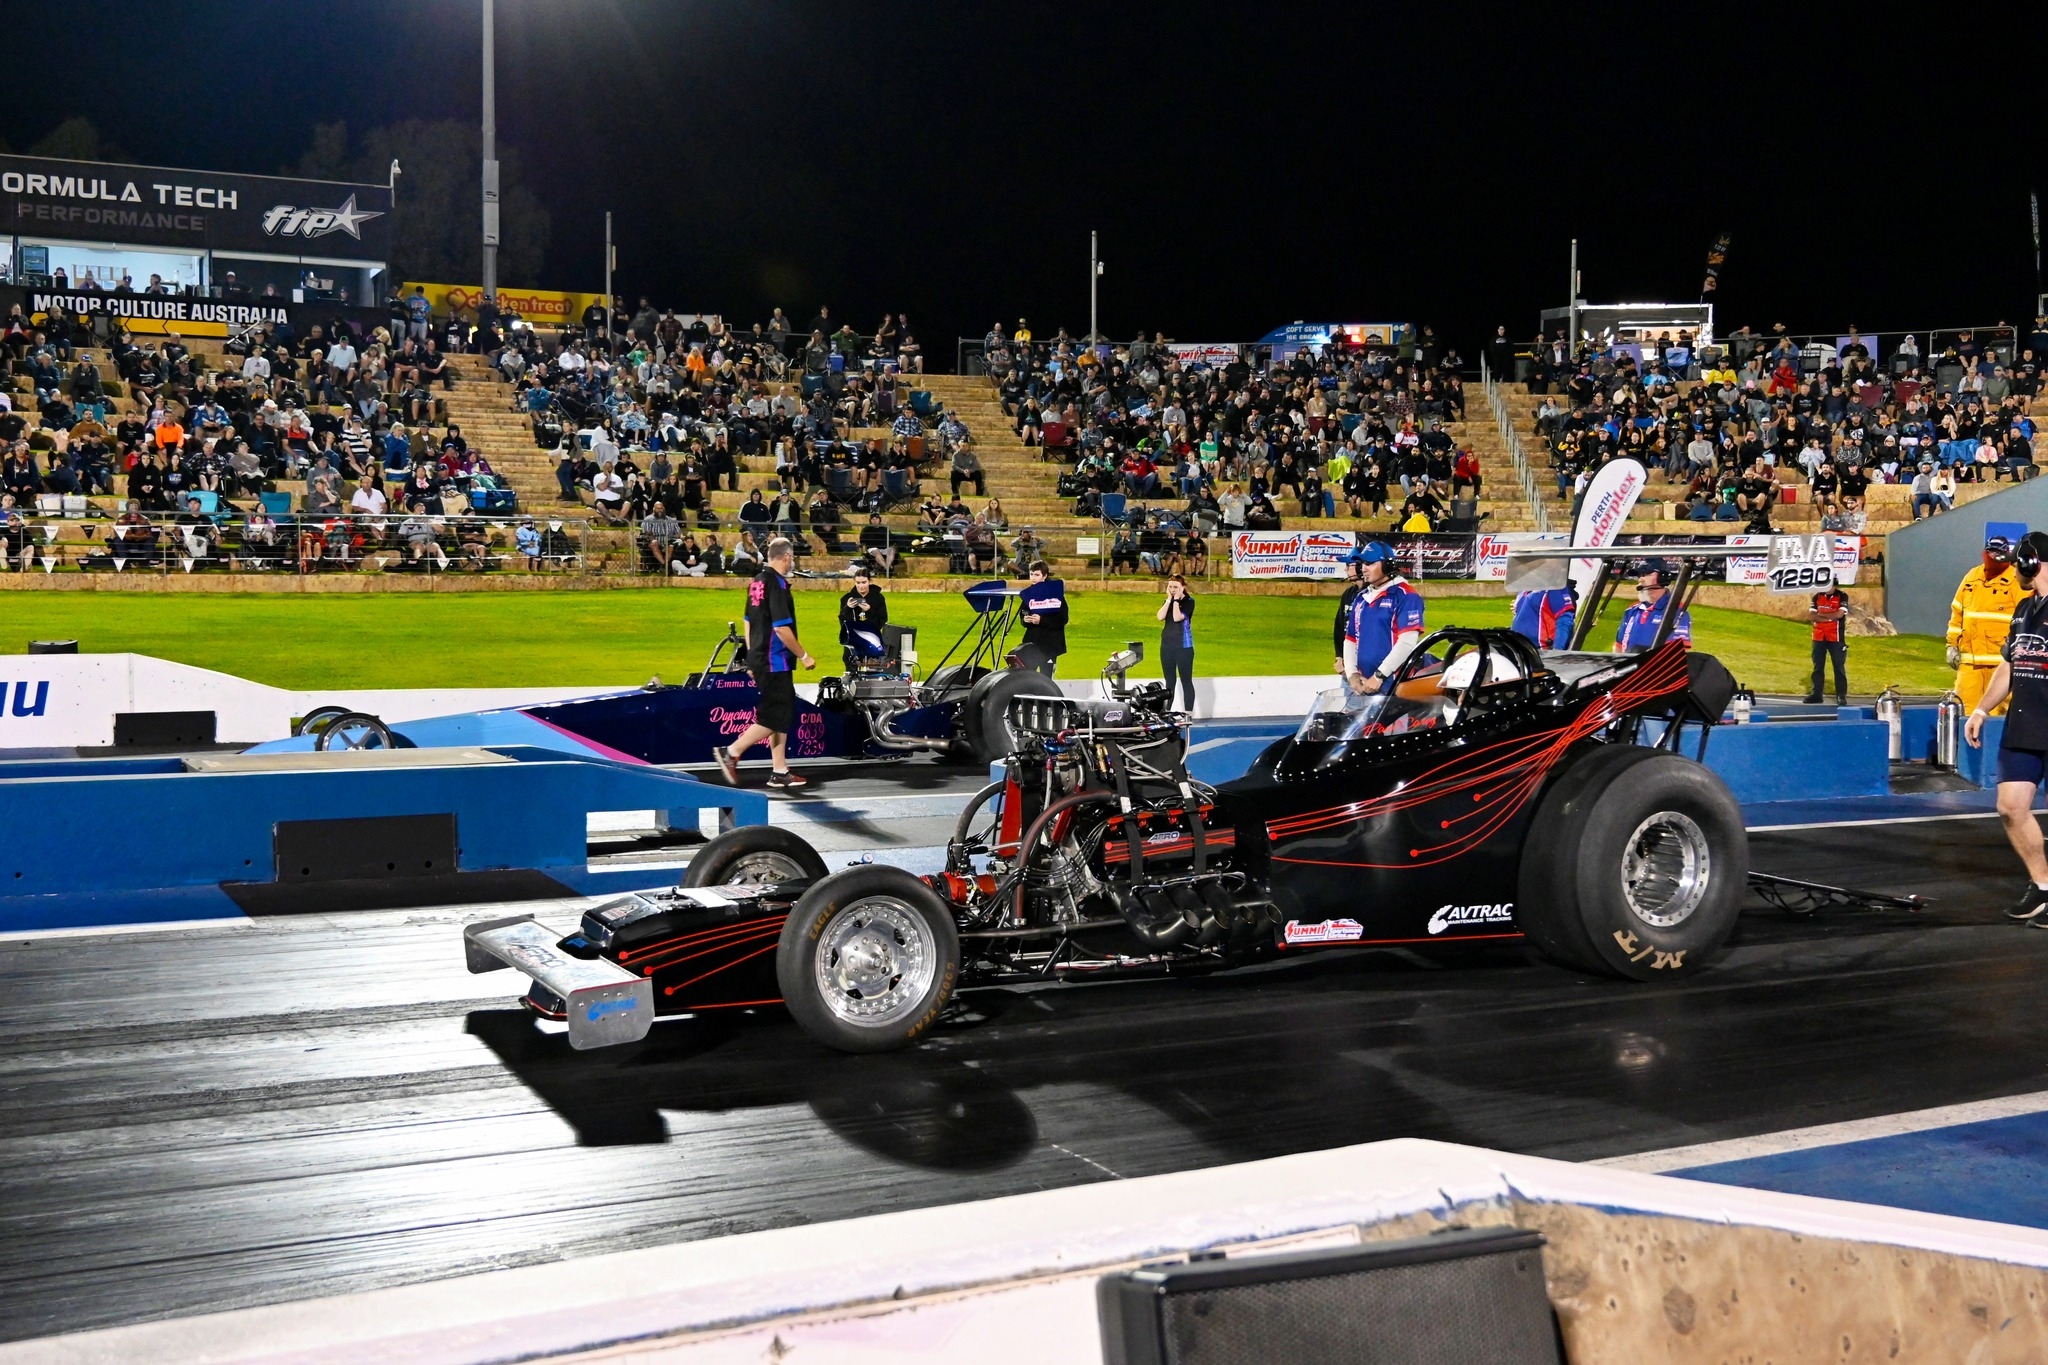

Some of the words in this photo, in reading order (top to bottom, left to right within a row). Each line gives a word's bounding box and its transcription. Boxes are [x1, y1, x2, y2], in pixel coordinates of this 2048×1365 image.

[2, 172, 141, 202] ORMULA
[153, 184, 238, 210] TECH
[20, 202, 205, 231] PERFORMANCE
[33, 294, 101, 314] MOTOR
[107, 298, 187, 320] CULTURE
[191, 303, 288, 324] AUSTRALIA
[532, 299, 572, 314] treat
[1304, 325, 1325, 333] SERVE
[1591, 491, 1612, 525] PERTH
[1581, 471, 1637, 570] otorplex
[1302, 553, 1331, 561] Series
[1407, 549, 1465, 557] RACING
[1775, 535, 1831, 564] TA/A
[1250, 564, 1336, 575] SummitRacing.com
[1768, 566, 1831, 590] 1290
[716, 679, 745, 689] Emma
[710, 707, 752, 724] Dancing
[800, 713, 823, 724] C/DA
[720, 719, 752, 735] Quee
[798, 723, 825, 740] 6839
[1149, 831, 1180, 841] AERO
[1447, 903, 1514, 919] AVTRAC
[809, 902, 837, 941] EAGLE
